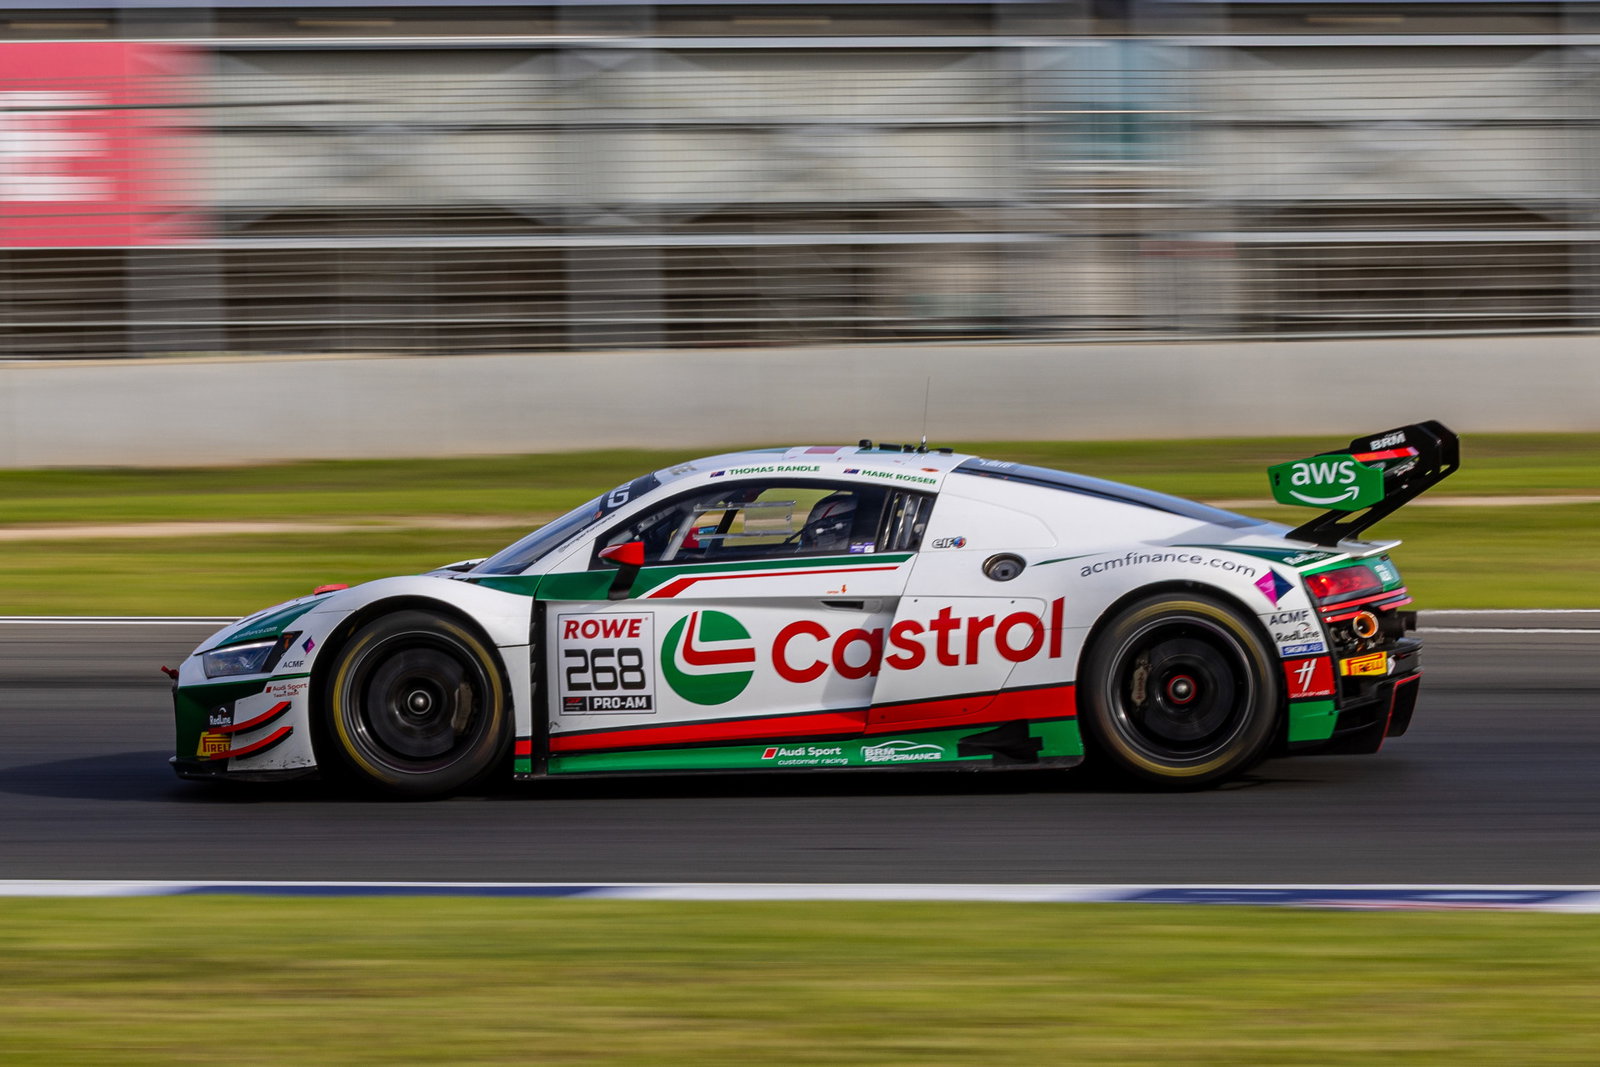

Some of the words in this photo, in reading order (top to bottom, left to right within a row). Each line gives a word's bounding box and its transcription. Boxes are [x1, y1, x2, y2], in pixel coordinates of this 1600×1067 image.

[1370, 433, 1406, 451] BRM
[729, 466, 774, 476] THOMAS
[777, 465, 820, 473] RANDLE
[861, 469, 894, 480] MARK
[895, 473, 937, 485] ROSSER
[1290, 460, 1357, 486] aws
[1079, 550, 1257, 578] acmfinance.com
[1269, 609, 1309, 626] ACMF
[563, 618, 642, 640] ROWE
[771, 596, 1065, 684] Castrol
[283, 660, 304, 669] ACMF
[563, 647, 646, 691] 268
[287, 683, 308, 691] Sport
[593, 696, 648, 709] PRO-AM
[777, 747, 806, 757] Audi
[807, 746, 842, 758] Sport
[864, 752, 942, 763] PERFORMANCE
[777, 758, 820, 766] customer
[820, 757, 849, 766] racing
